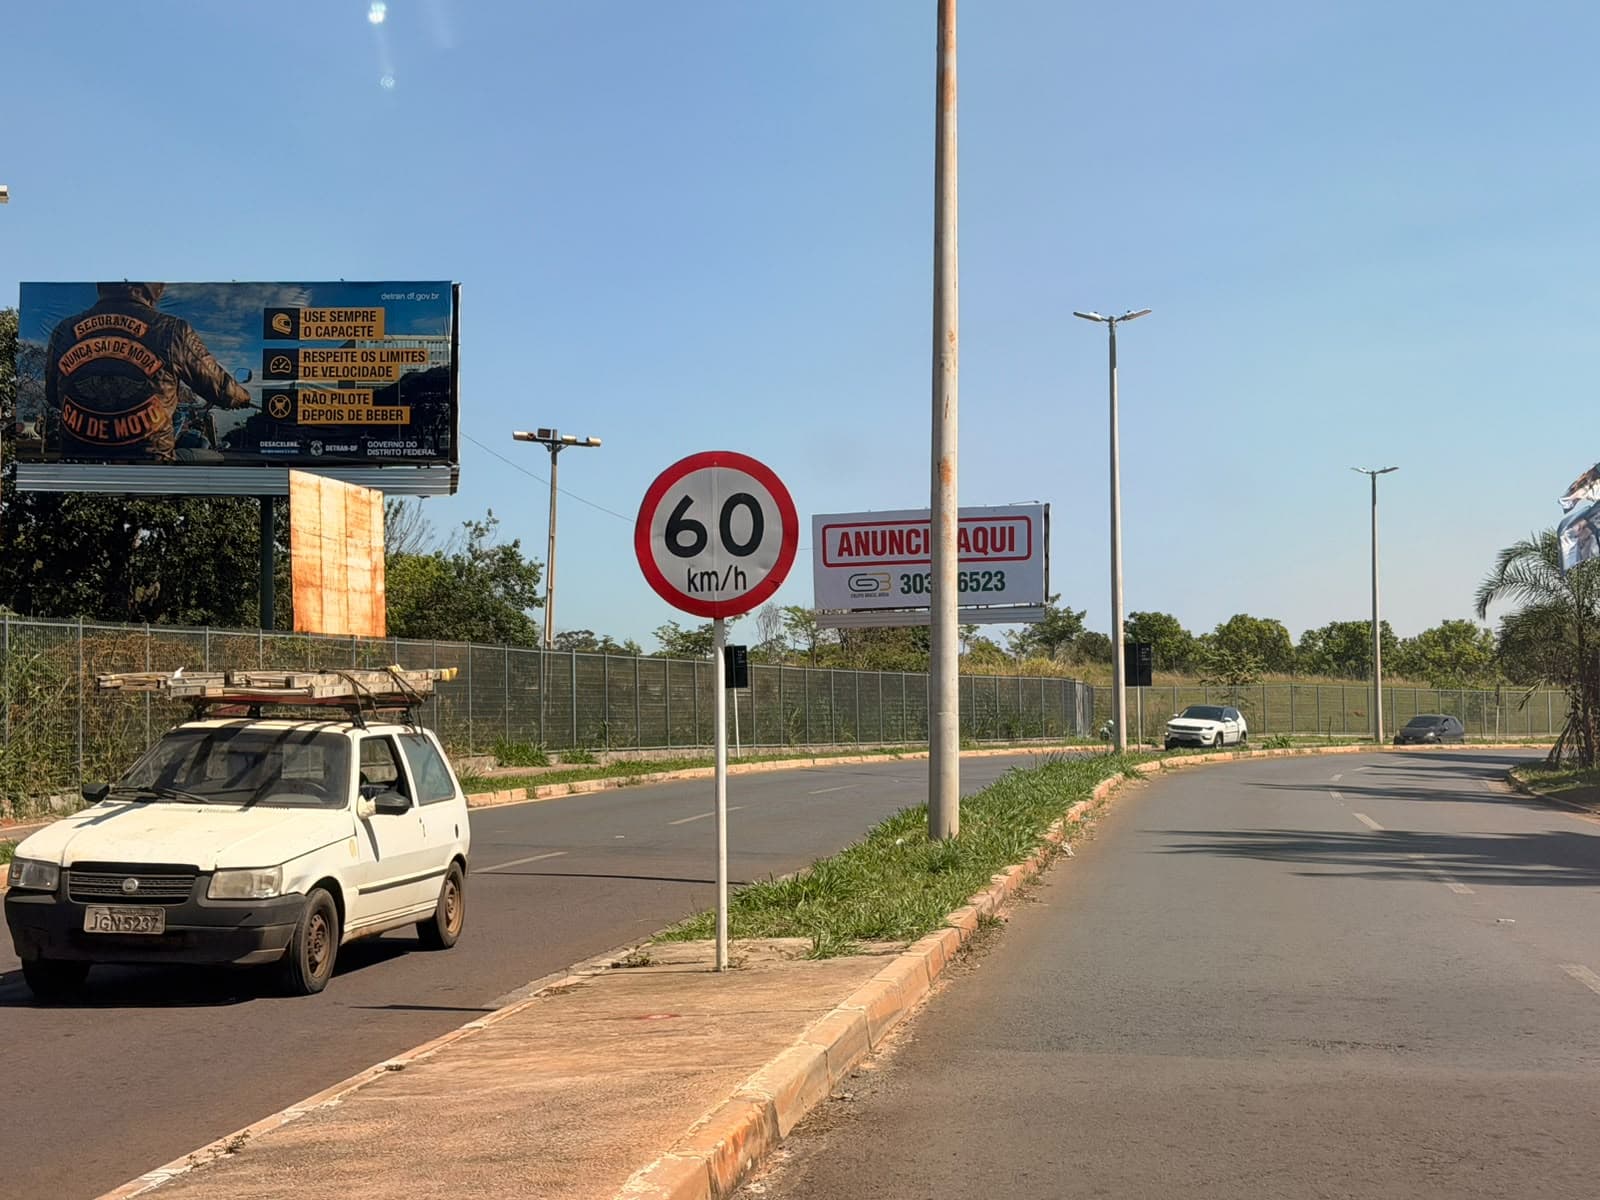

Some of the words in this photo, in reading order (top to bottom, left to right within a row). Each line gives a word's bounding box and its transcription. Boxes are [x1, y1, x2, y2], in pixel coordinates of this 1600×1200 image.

[304, 310, 326, 322] USE
[329, 310, 377, 322] SEMPRE
[304, 326, 312, 337] O
[315, 326, 374, 337] CAPACETE
[61, 344, 93, 372] NUNCA
[94, 340, 111, 353] SAI
[113, 341, 128, 354] DE
[127, 346, 156, 372] MODA
[303, 351, 357, 362] RESPEITE
[361, 351, 376, 363] OS
[380, 351, 425, 363] LIMITES
[303, 366, 318, 377] DE
[321, 366, 393, 377] VELOCIDADE
[330, 393, 369, 405] PILOTE
[63, 404, 84, 433] SAI
[86, 417, 109, 439] DE
[114, 403, 161, 438] MOTO
[302, 409, 344, 421] DEPOIS
[348, 409, 363, 420] DE
[366, 409, 404, 421] BEBER
[367, 441, 404, 449] GOVERNO
[367, 448, 402, 456] DISTRITO
[402, 448, 437, 456] FEDERAL
[665, 492, 764, 558] 60
[837, 528, 930, 557] ANUNCI
[958, 526, 1015, 556] AQUI
[687, 565, 747, 592] km/h
